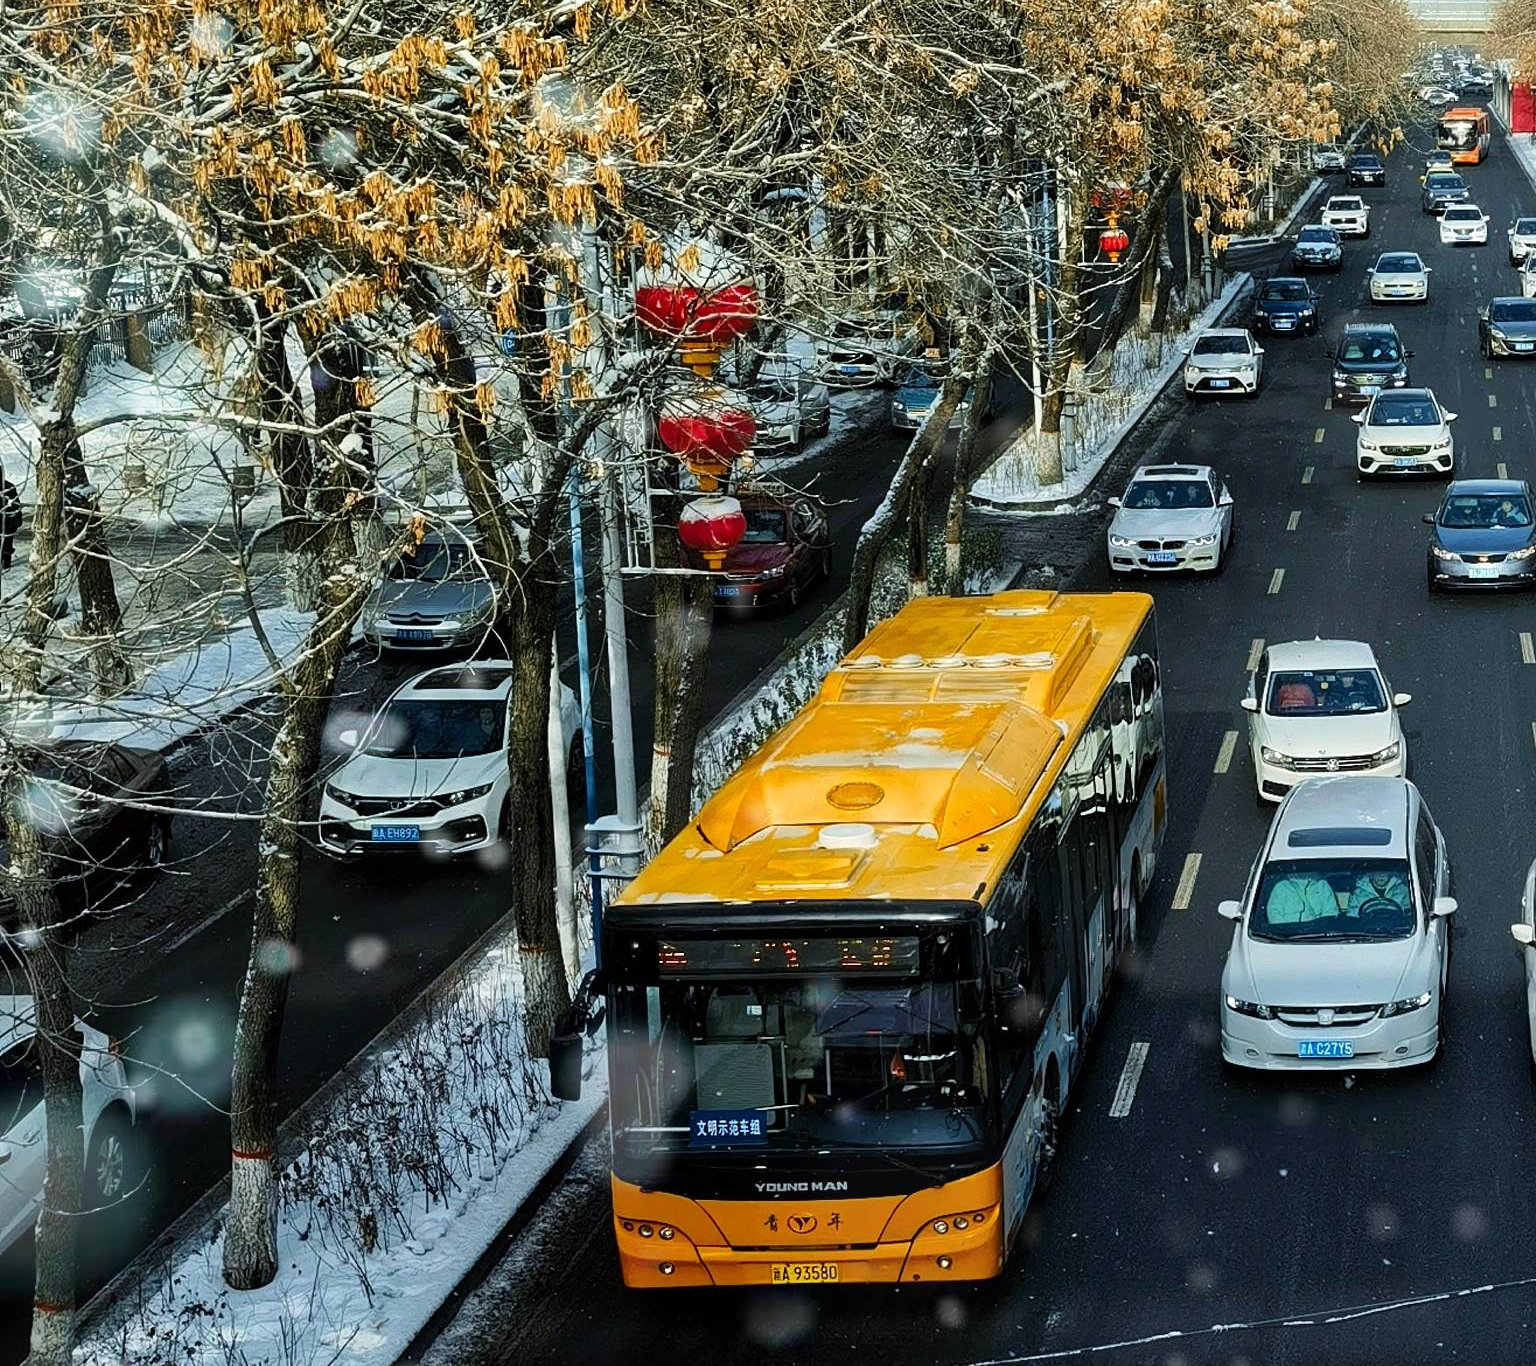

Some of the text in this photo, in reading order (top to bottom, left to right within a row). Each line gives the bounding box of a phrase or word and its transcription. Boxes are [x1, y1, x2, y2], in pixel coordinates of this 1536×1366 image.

[696, 1118, 761, 1136] 文明示范车组
[754, 1181, 848, 1192] YOUNG MAN
